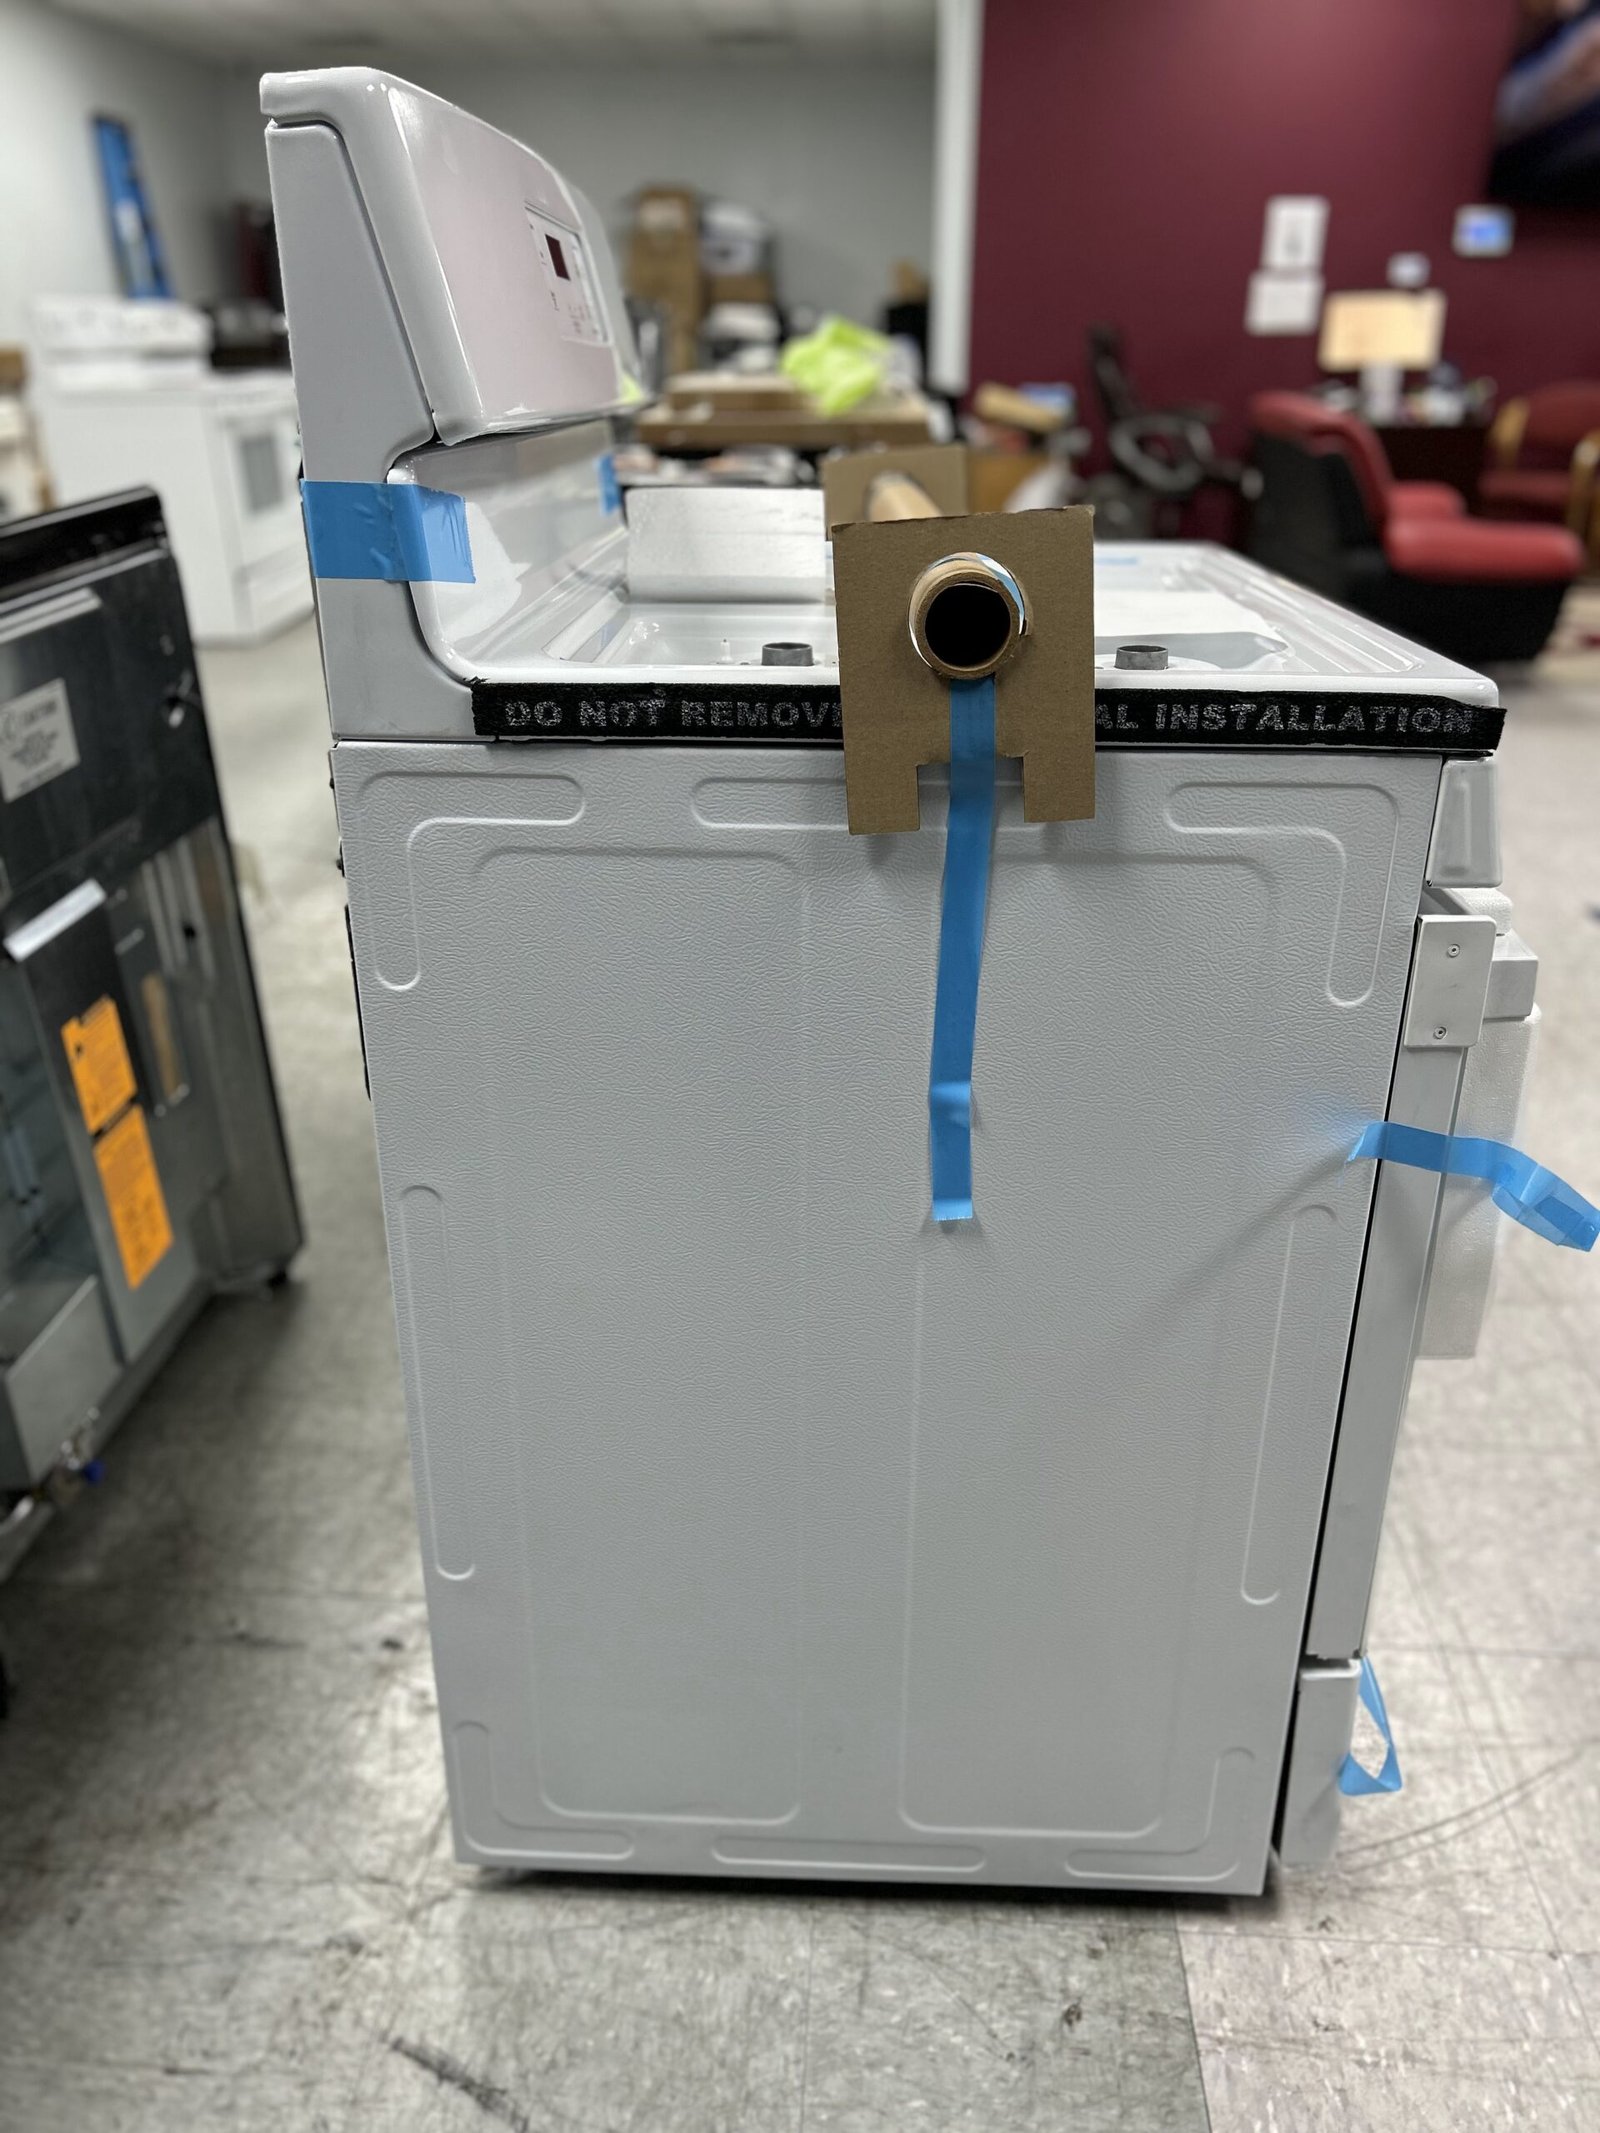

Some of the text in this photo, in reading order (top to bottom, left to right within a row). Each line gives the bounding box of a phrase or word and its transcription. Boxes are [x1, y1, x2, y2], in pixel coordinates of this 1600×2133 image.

[504, 701, 563, 727] DO
[579, 700, 666, 727] NOT
[1155, 704, 1473, 733] INSTALLATION
